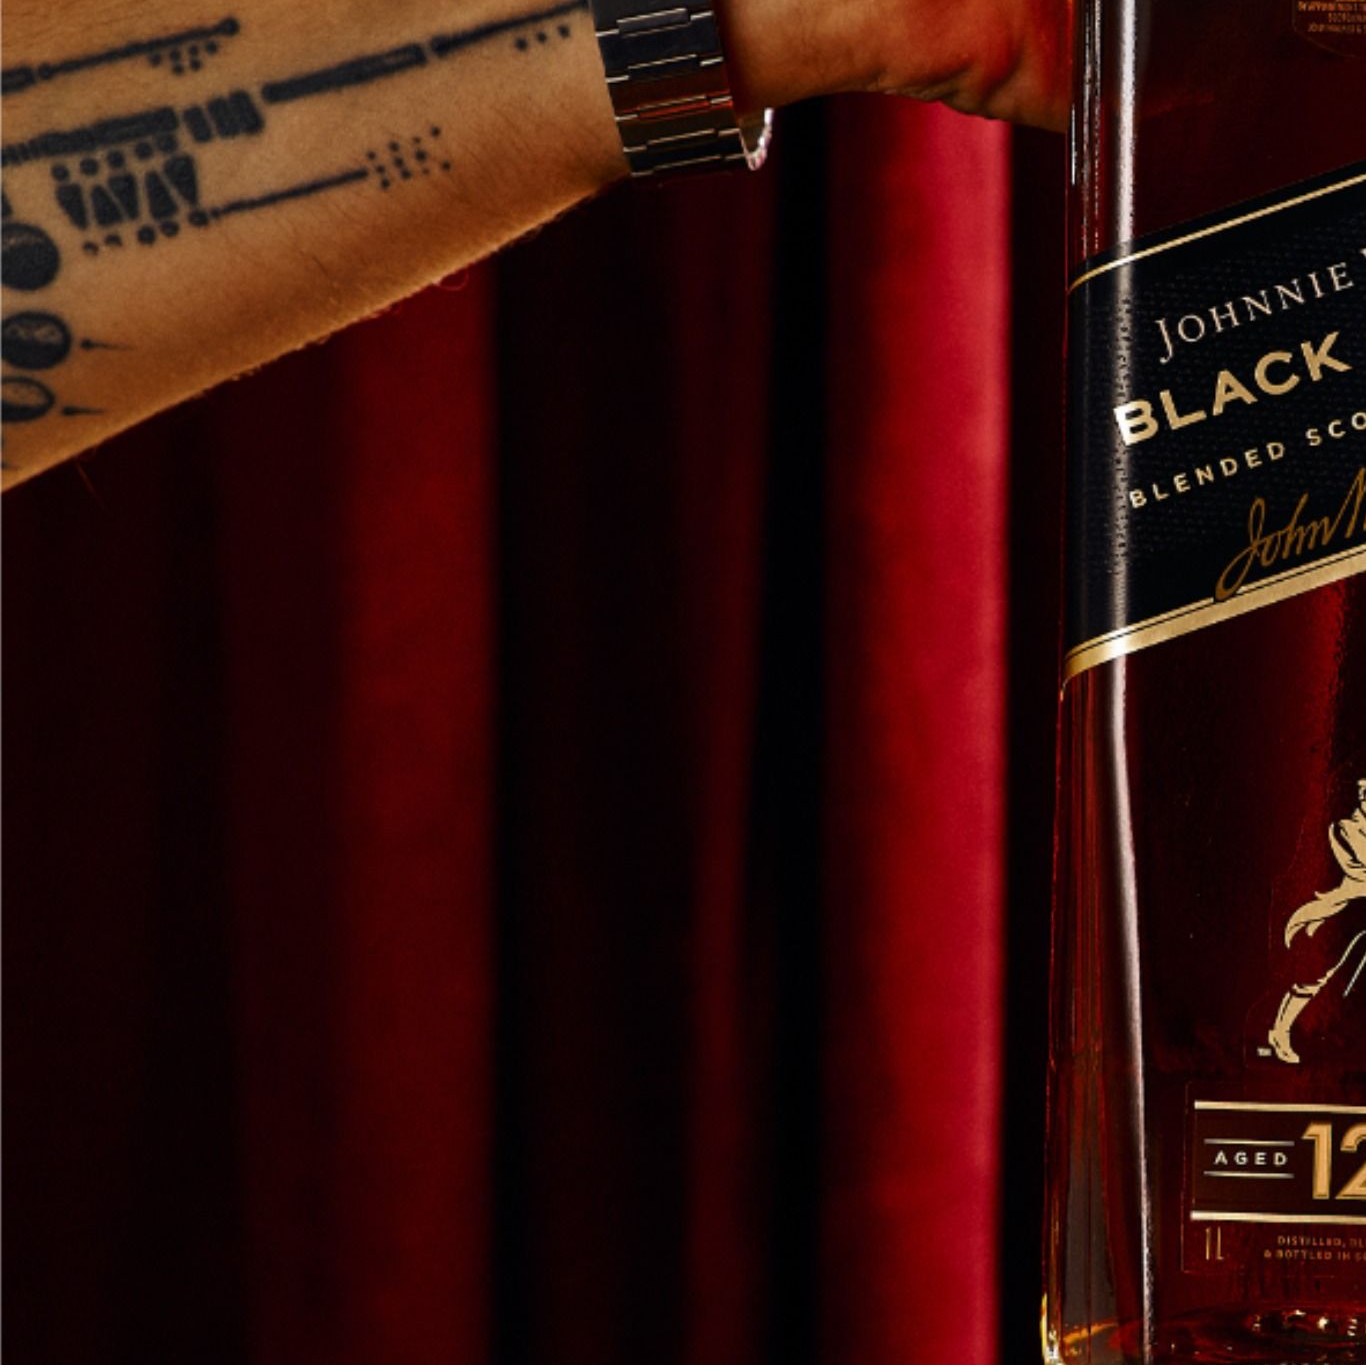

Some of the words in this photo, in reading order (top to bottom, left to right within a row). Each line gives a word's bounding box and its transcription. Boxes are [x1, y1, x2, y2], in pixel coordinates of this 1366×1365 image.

[1154, 262, 1355, 363] JOHNNIE
[1113, 331, 1353, 445] BLACK
[1129, 442, 1286, 509] BLENDED
[1213, 492, 1336, 601] John
[1213, 1150, 1289, 1166] AGED
[1275, 1249, 1333, 1261] BOTTLED
[1337, 1251, 1352, 1262] IN
